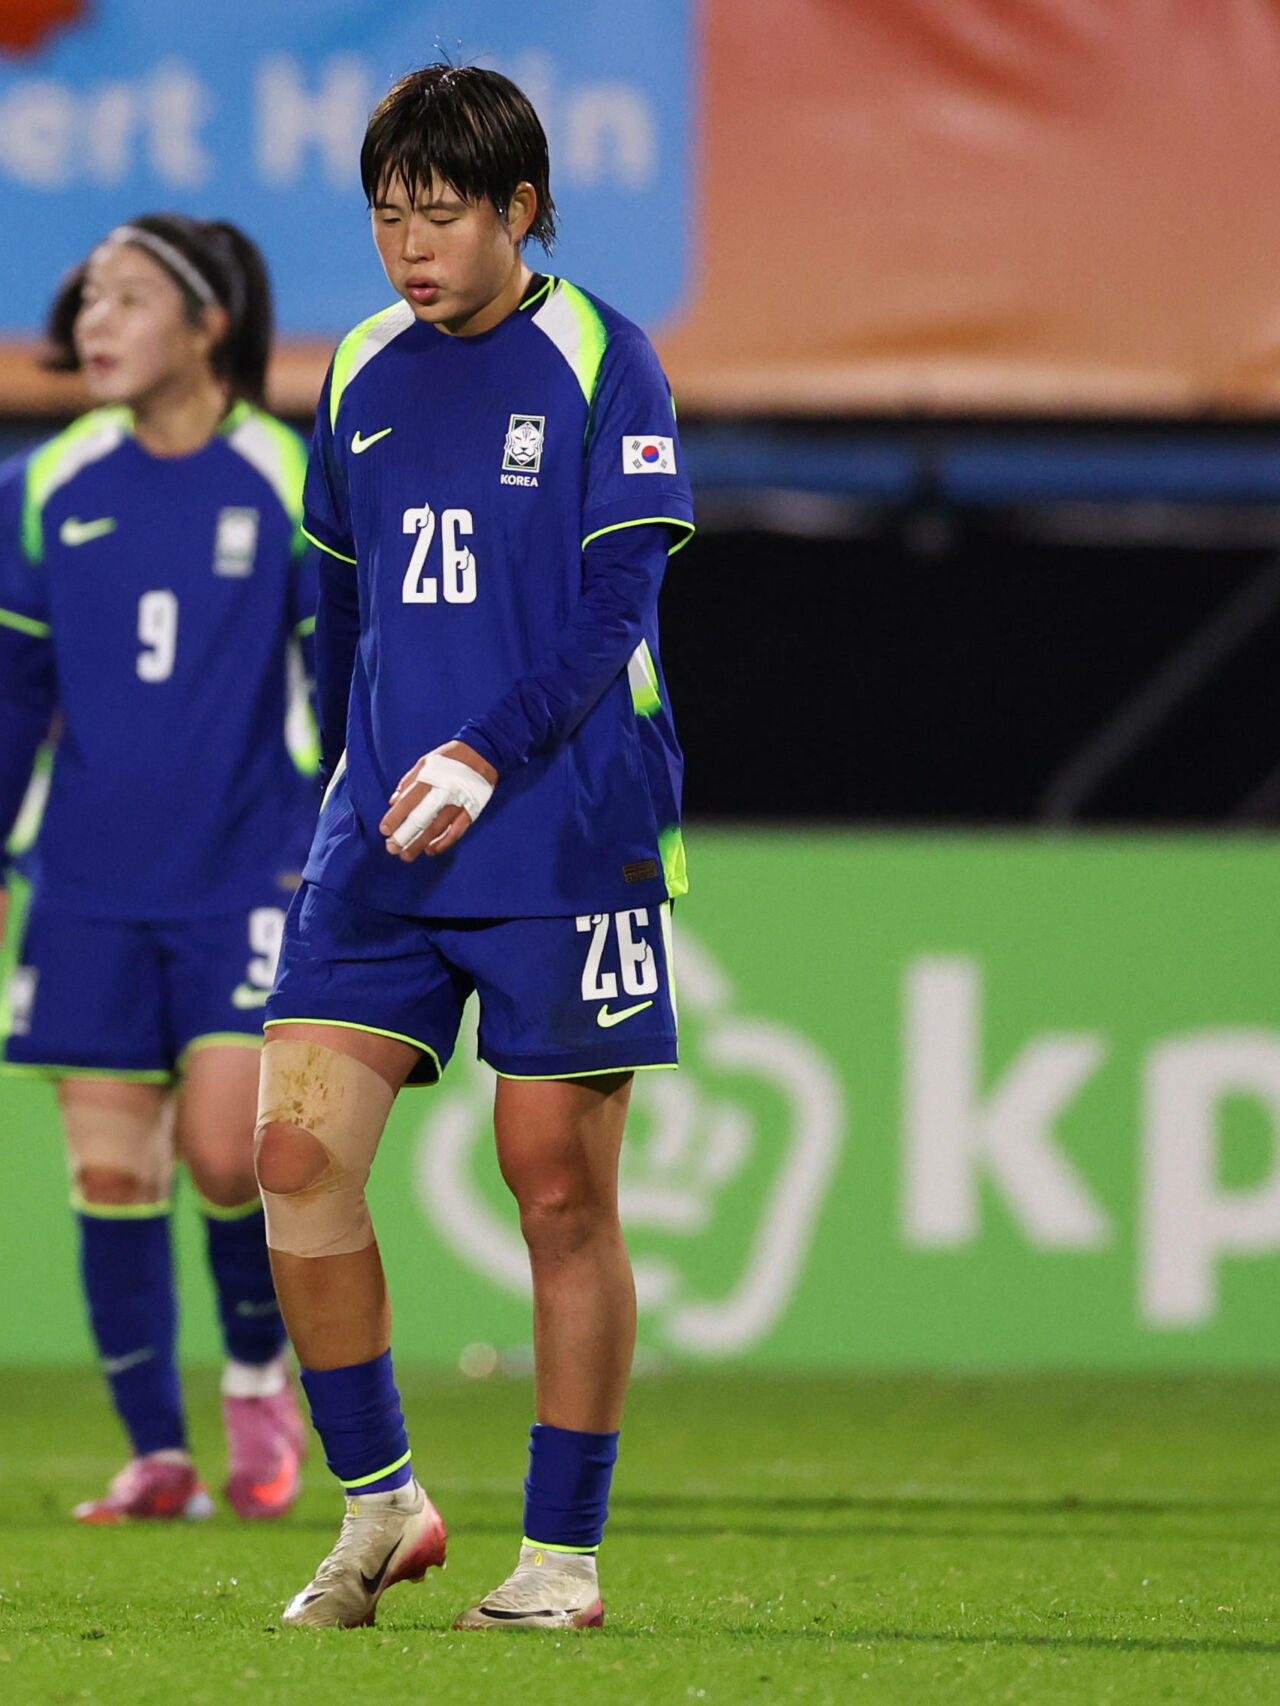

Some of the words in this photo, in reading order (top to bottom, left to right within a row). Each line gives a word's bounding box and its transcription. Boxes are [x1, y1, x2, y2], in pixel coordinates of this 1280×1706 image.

[500, 473, 539, 488] KOREA
[402, 503, 477, 604] 26
[136, 589, 179, 683] 9
[247, 906, 287, 989] 9
[575, 907, 659, 1001] 26
